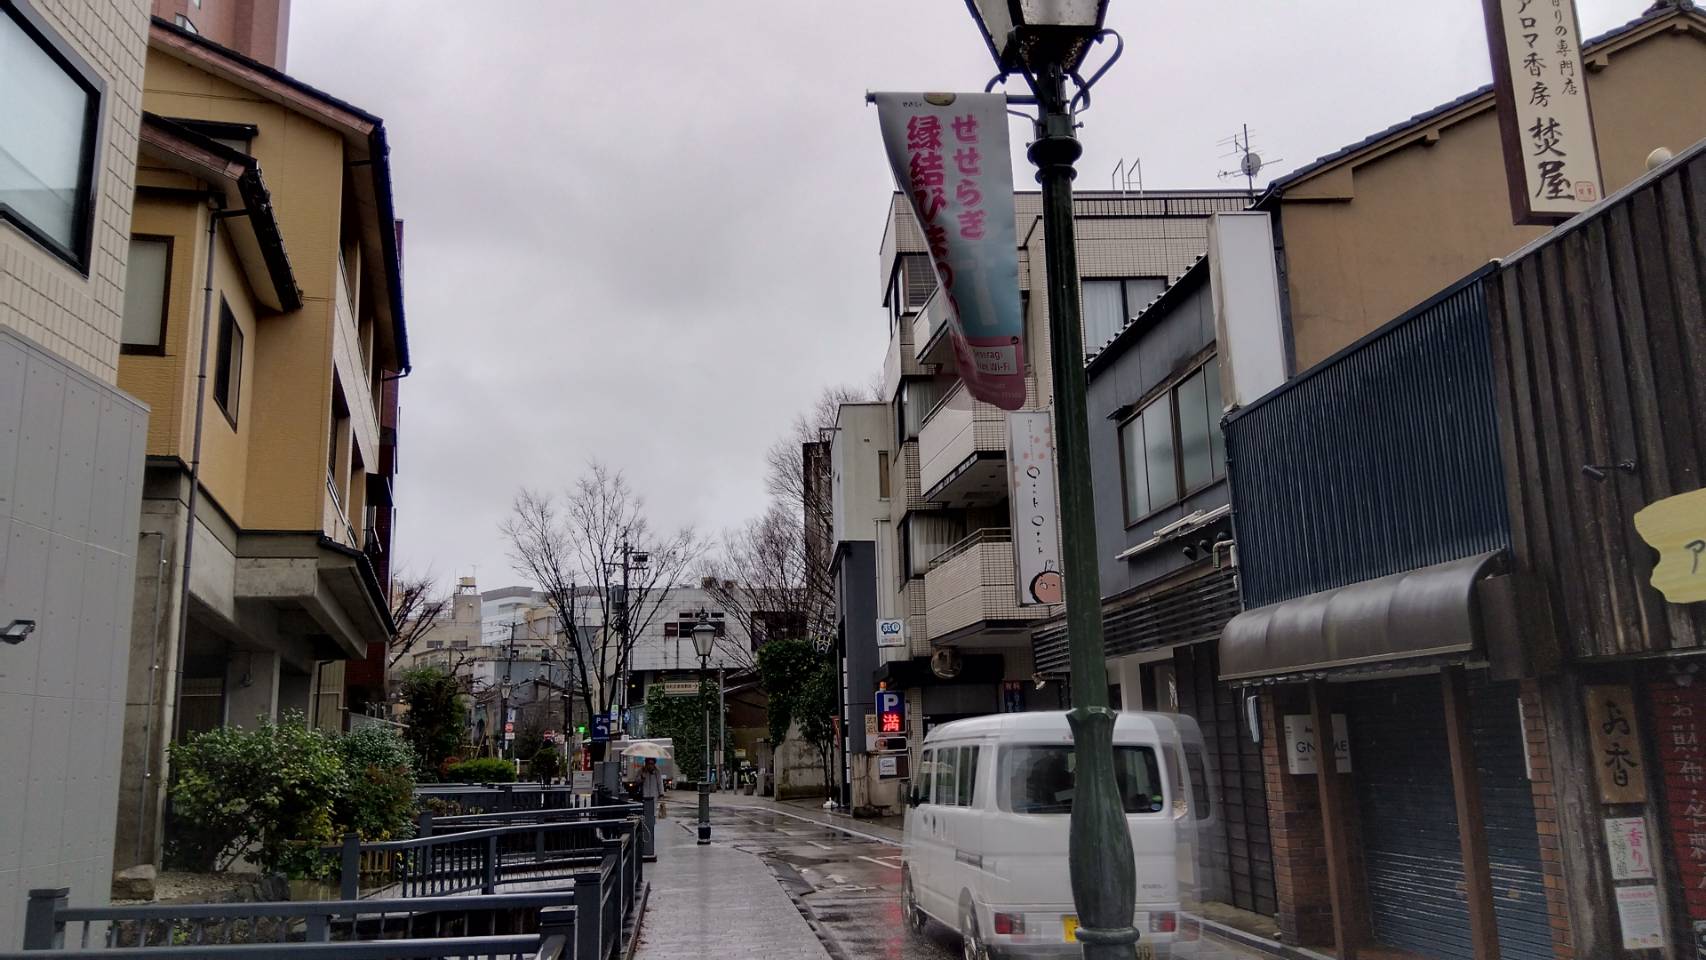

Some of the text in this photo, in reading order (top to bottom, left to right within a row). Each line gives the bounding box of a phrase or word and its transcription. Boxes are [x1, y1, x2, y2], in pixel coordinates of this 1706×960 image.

[951, 114, 987, 240] せせらぎ
[883, 714, 900, 731] 満
[884, 694, 899, 711] P
[1602, 700, 1637, 789] お香
